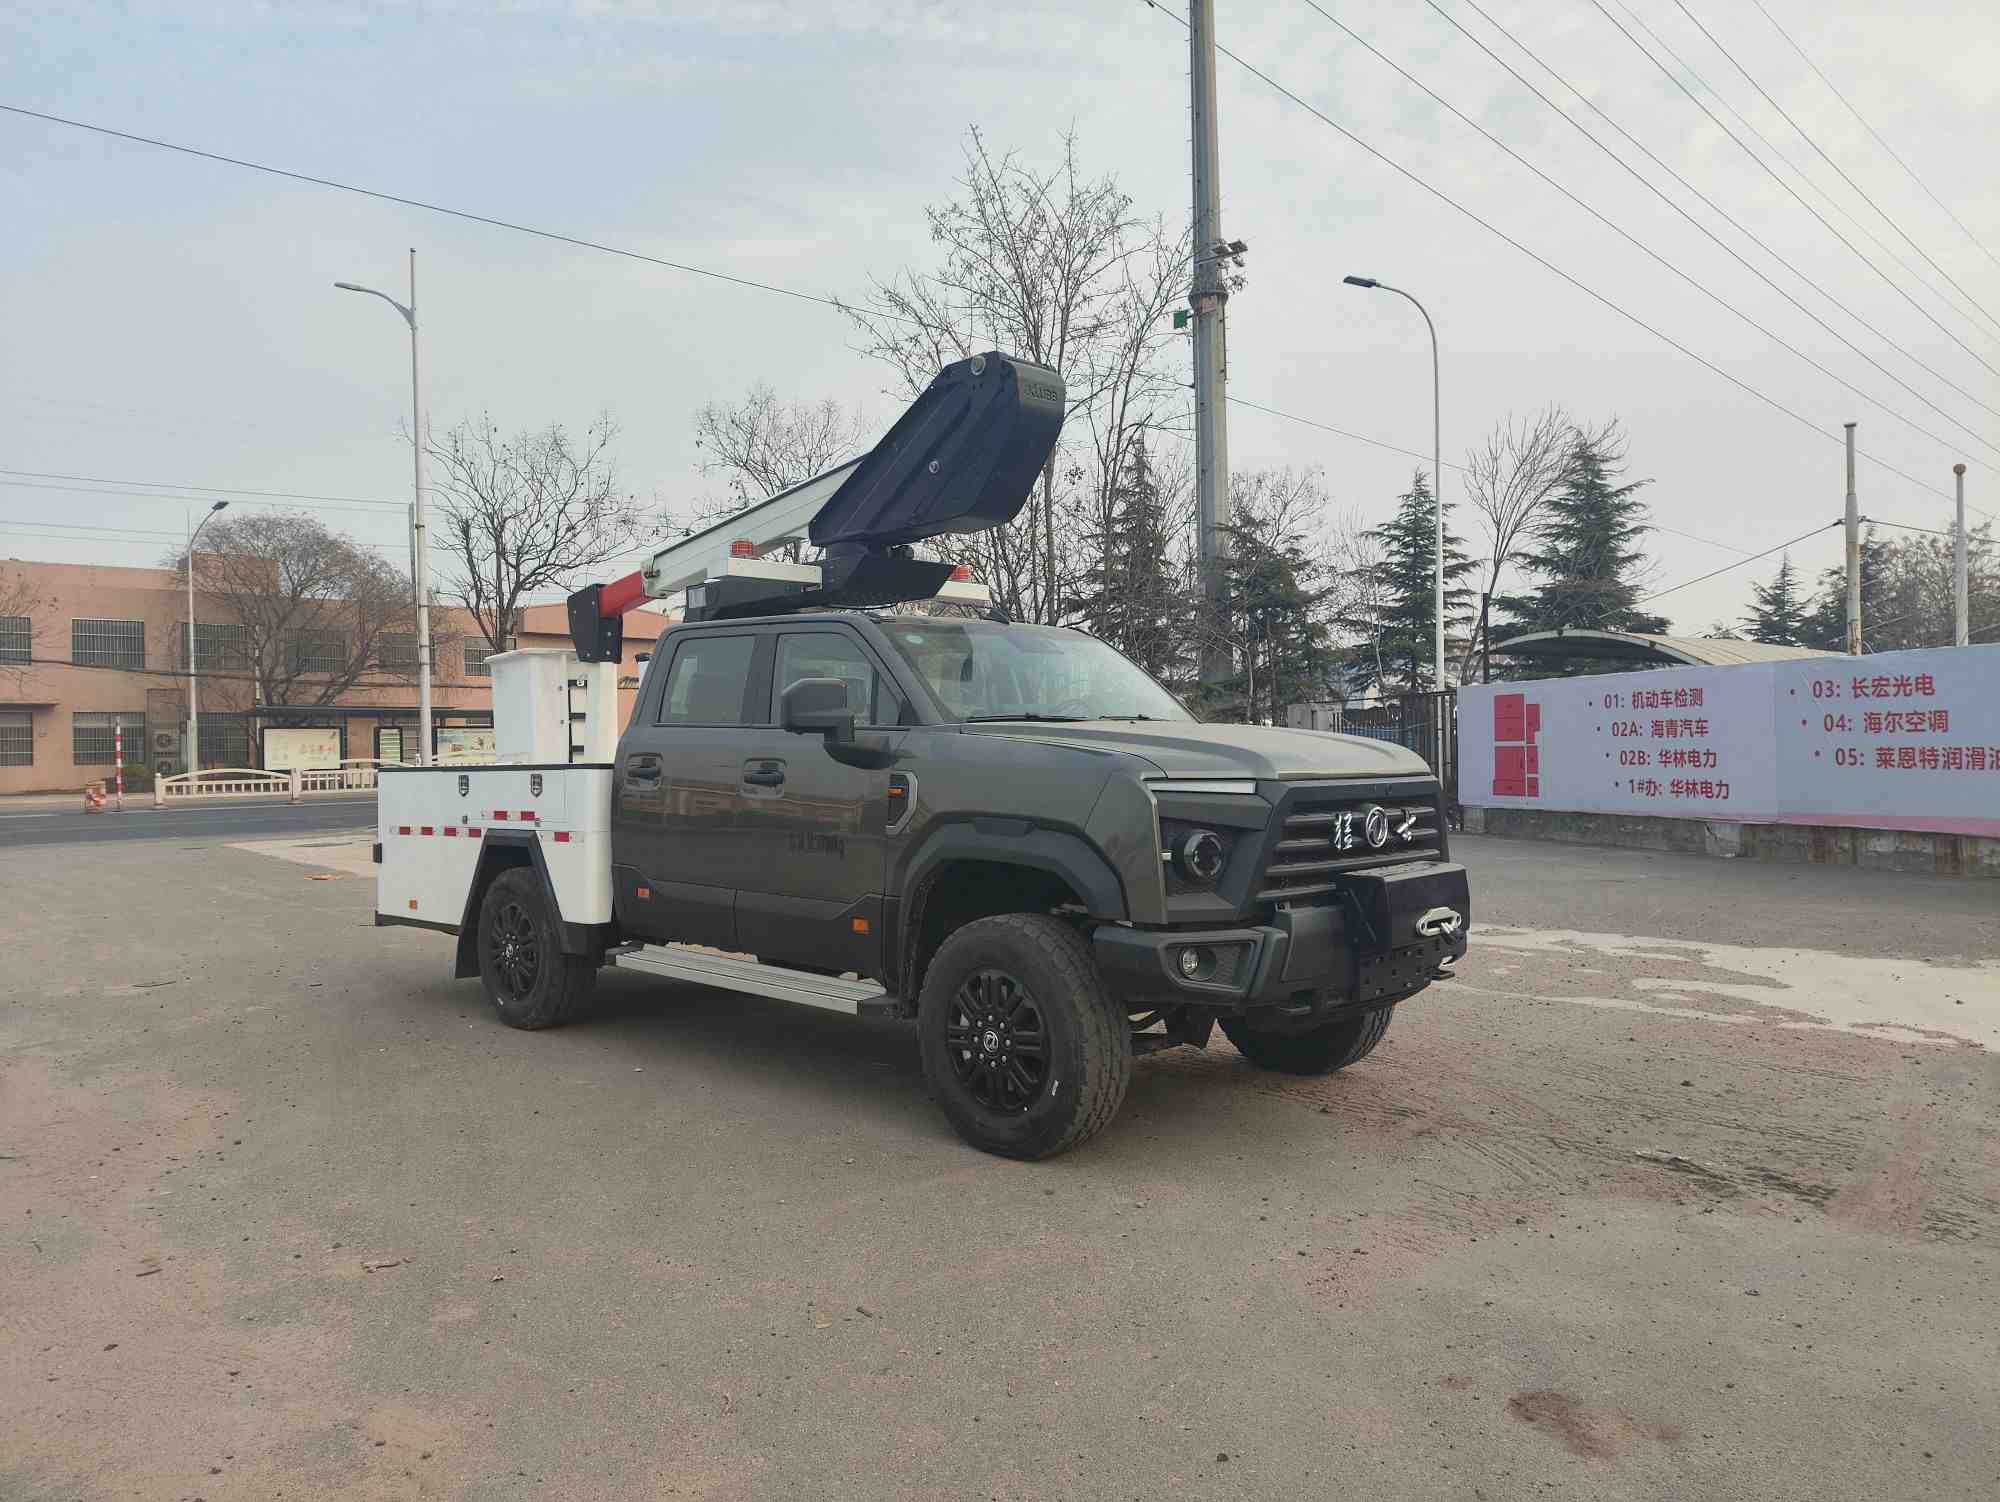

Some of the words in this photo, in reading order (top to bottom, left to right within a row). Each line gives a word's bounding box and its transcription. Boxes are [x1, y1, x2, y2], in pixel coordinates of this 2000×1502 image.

[1812, 679, 1841, 698] 03:
[1852, 672, 1936, 699] 长宏光电
[1604, 693, 1625, 709] 01:
[1632, 687, 1704, 710] 机动车检测
[1612, 720, 1643, 737] 02A:
[1651, 718, 1709, 738] 海青汽车
[1824, 713, 1852, 732] 04:
[1863, 709, 1949, 733] 海尔空调
[1620, 750, 1651, 766] 02B:
[1659, 748, 1717, 769] 华林电力
[1835, 747, 1865, 766] 05:
[1629, 778, 1663, 797] 1#办:
[1670, 777, 1729, 800] 华林电力
